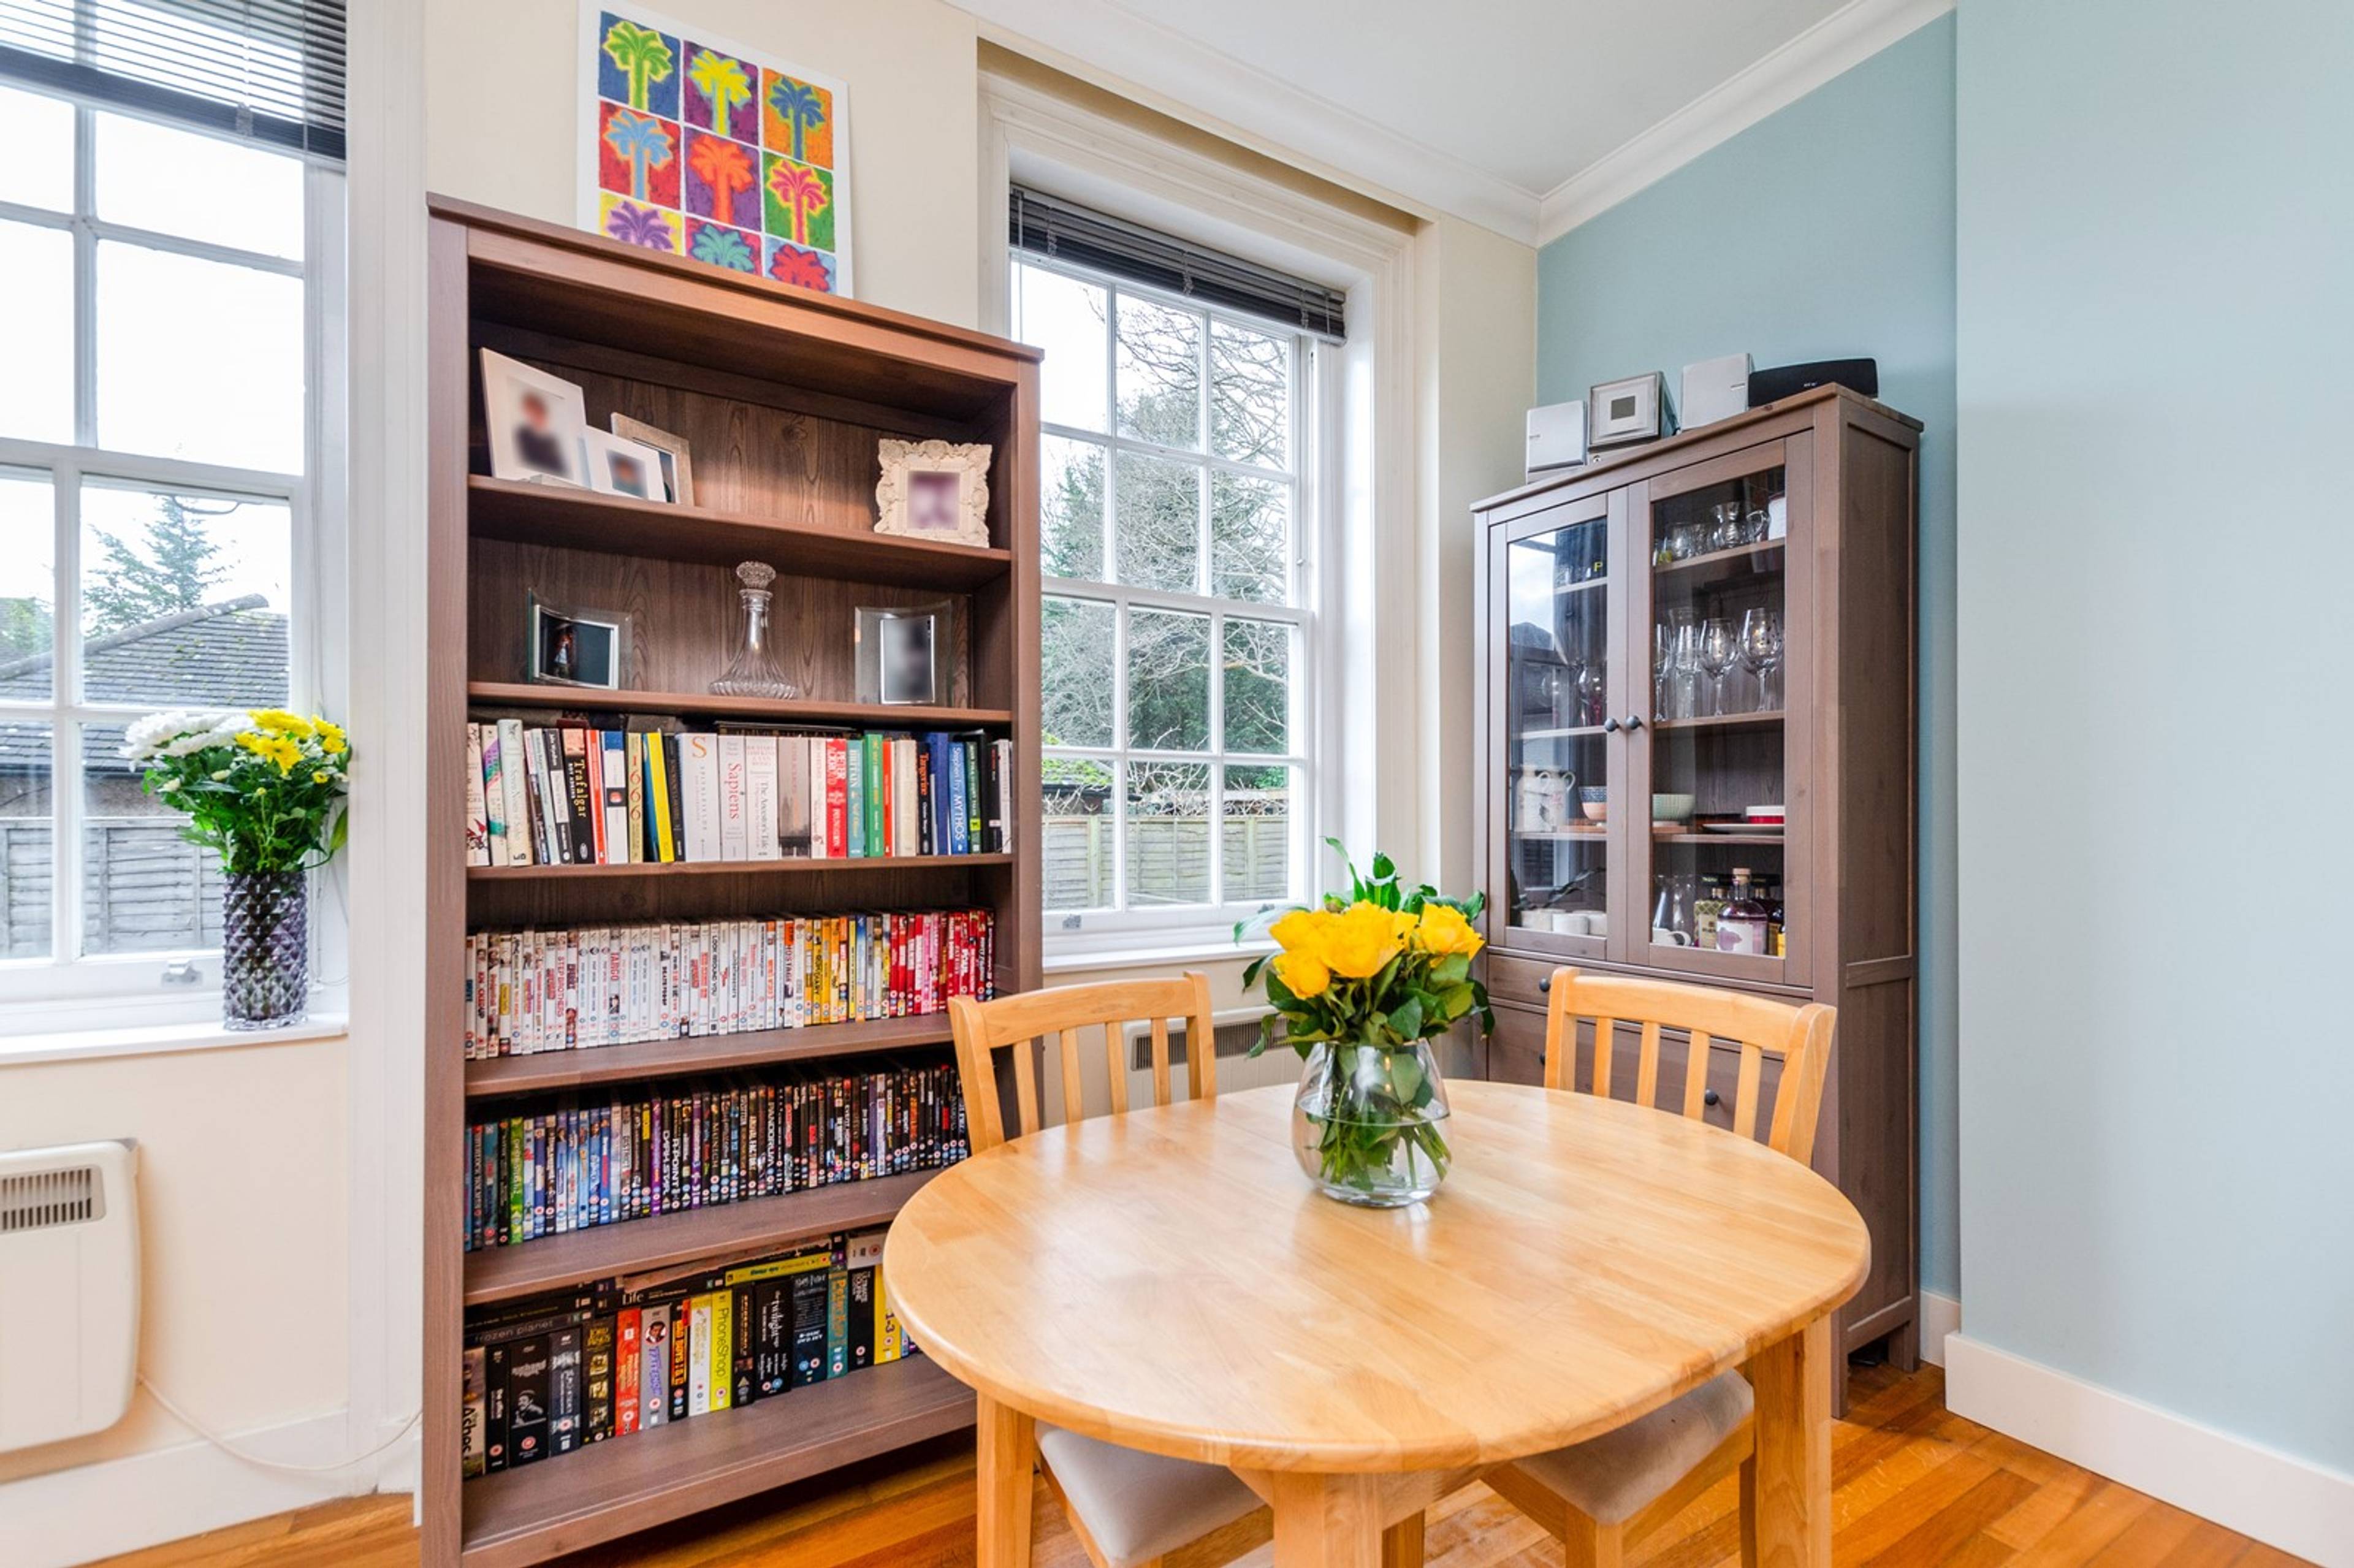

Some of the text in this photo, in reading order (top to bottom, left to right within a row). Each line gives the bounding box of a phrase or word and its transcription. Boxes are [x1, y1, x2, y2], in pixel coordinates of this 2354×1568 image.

[691, 736, 707, 759] S
[952, 747, 964, 778] Stephen
[574, 759, 589, 818] Trafalgar
[724, 763, 743, 820] Sapiens
[761, 782, 769, 795] The
[919, 752, 930, 796] Tangerine
[954, 793, 965, 841] MYTHOS
[557, 976, 565, 1018] BROTHERS
[767, 1102, 775, 1167] PANDORUM
[622, 1291, 644, 1306] Life
[476, 1320, 554, 1343] frozen planet
[768, 1300, 785, 1337] twilight
[674, 1340, 685, 1363] BOYS
[715, 1308, 730, 1378] PhoneShop
